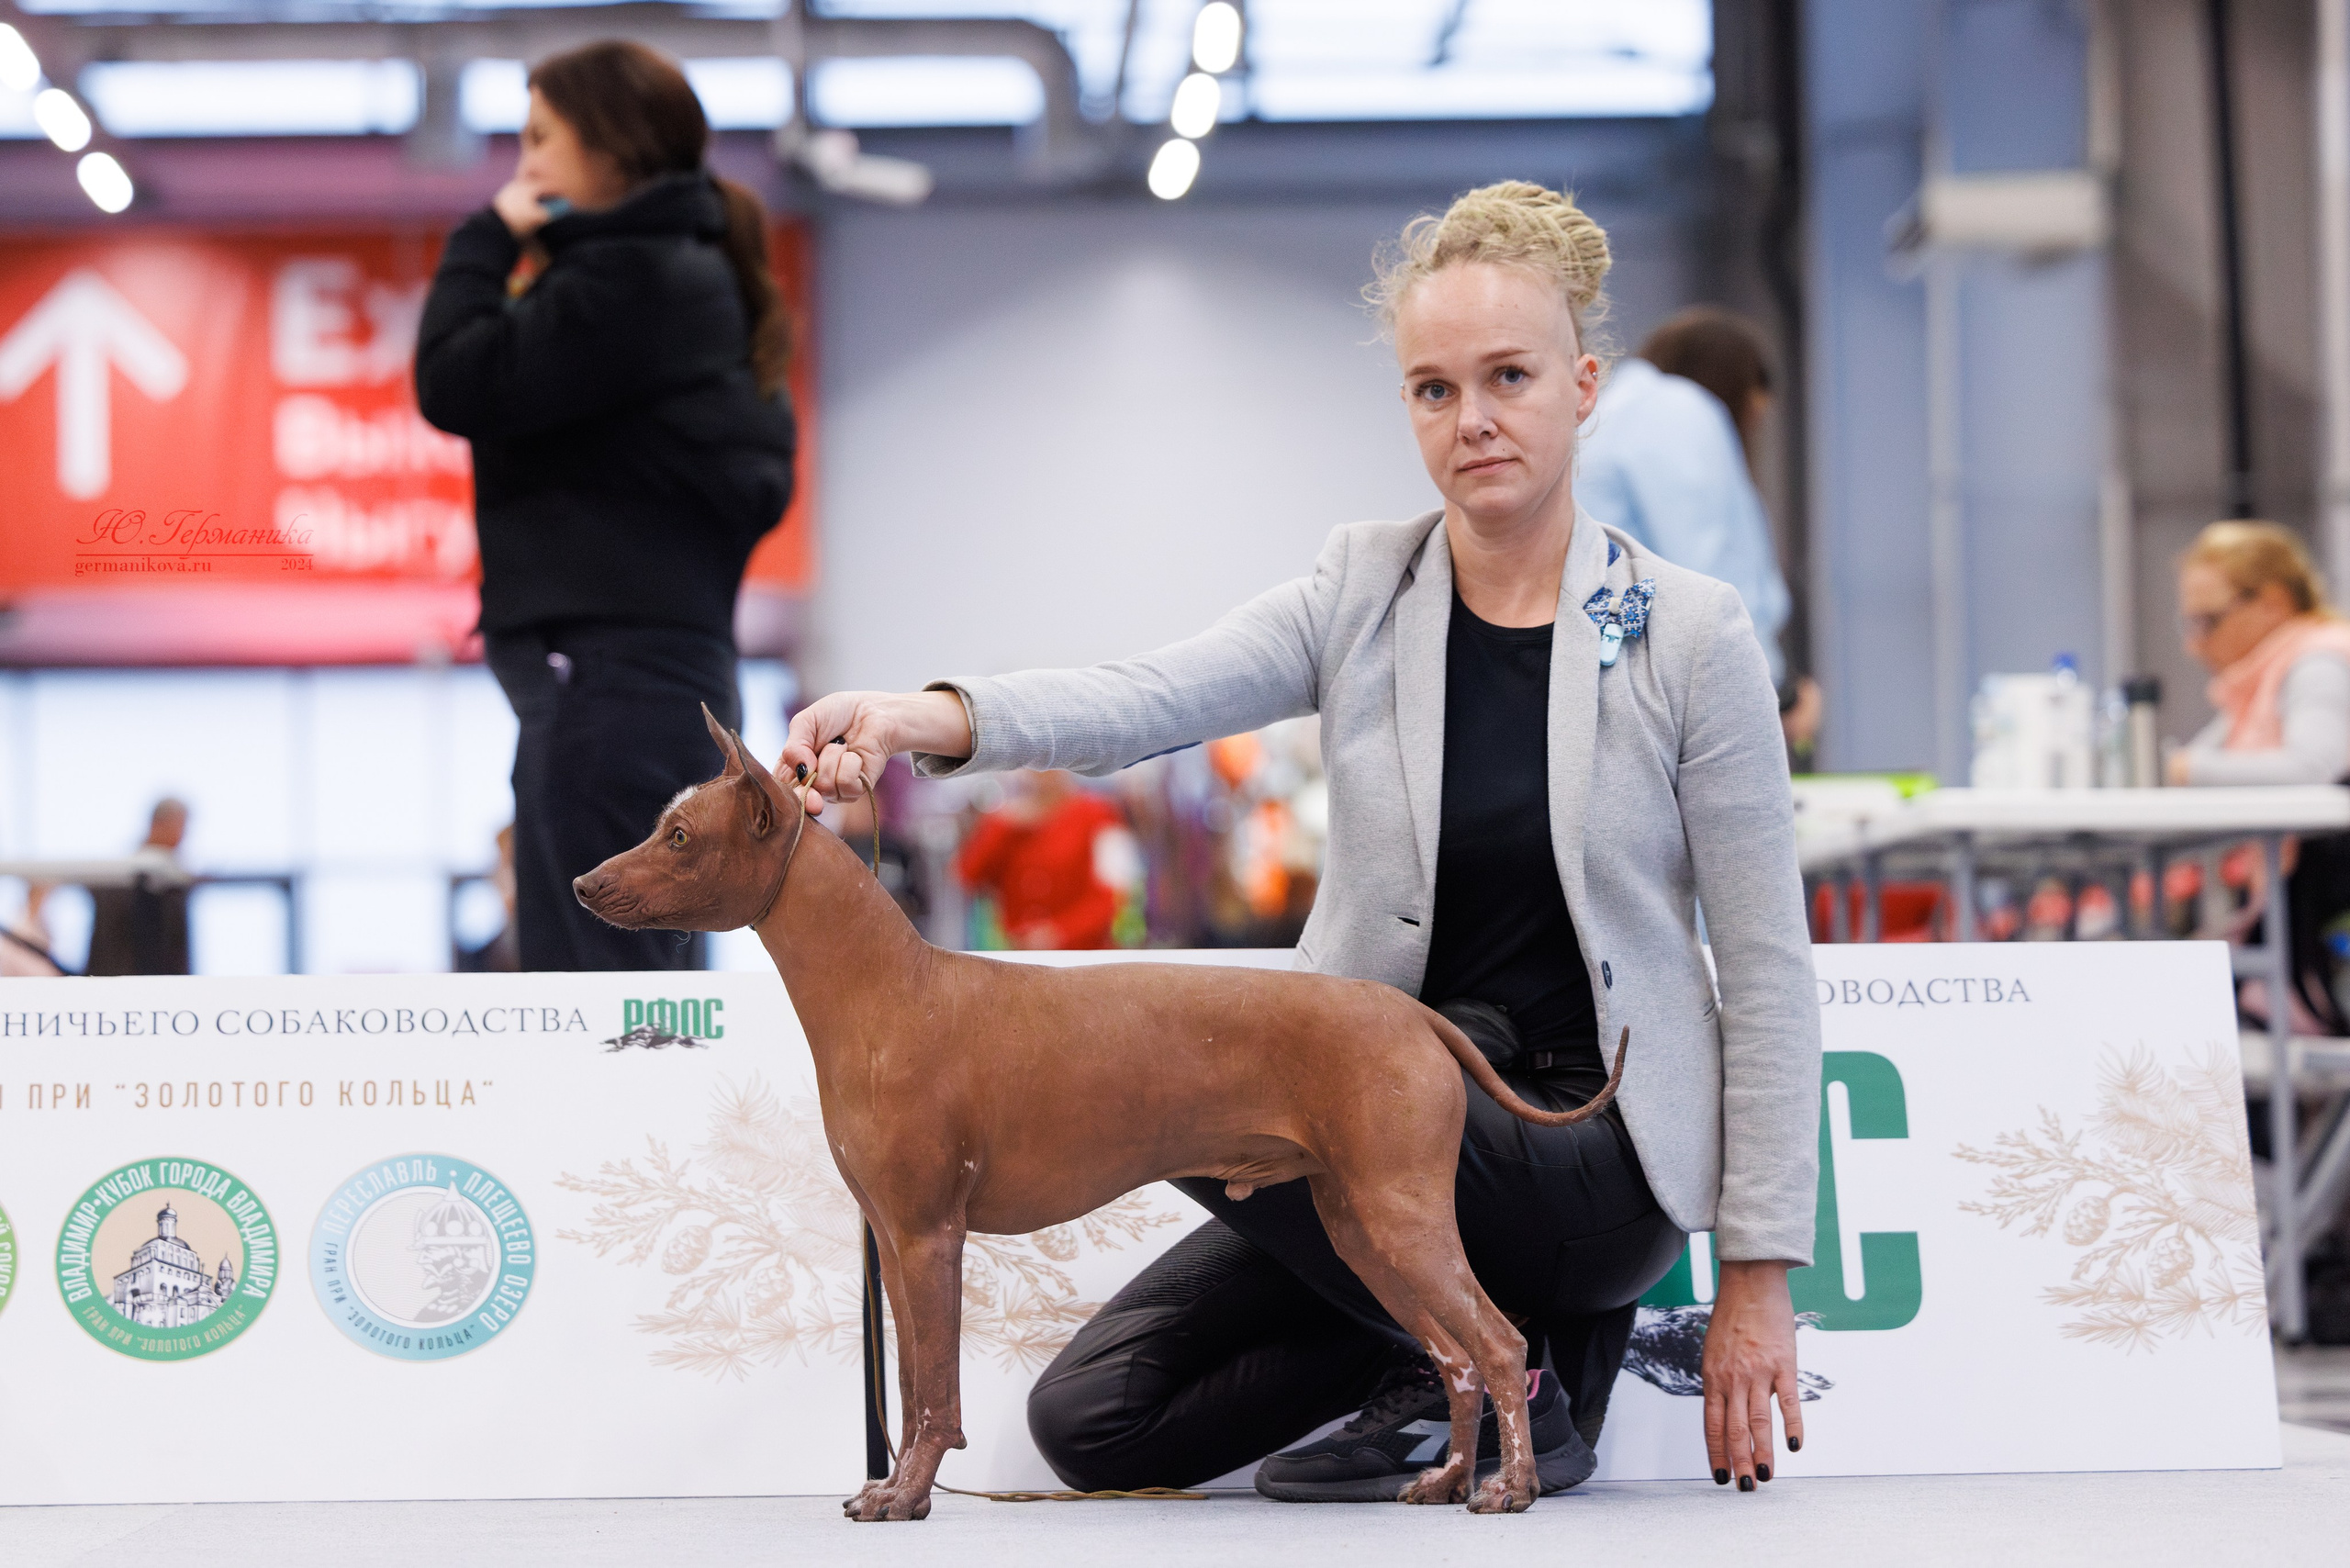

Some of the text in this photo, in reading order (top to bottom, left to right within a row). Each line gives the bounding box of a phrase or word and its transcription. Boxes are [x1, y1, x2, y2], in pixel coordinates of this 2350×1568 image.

[2, 1005, 589, 1037] НИЧЬЕГО СОБАКОВОДСТВА
[623, 997, 723, 1039] РФПС
[28, 1082, 91, 1110] ПРИ
[61, 1201, 101, 1304] ВЛАДИМИР
[95, 1163, 154, 1207] КУБОК
[159, 1161, 232, 1200] ГОРОДА
[226, 1189, 275, 1299] ВЛАДИМИРА
[321, 1159, 532, 1332] ПЕРЕСЛАВЛЬ ПЛЕЩЕЕВО ОЗЕРО
[323, 1241, 339, 1272] ГРАН
[327, 1279, 348, 1304] ПРИ
